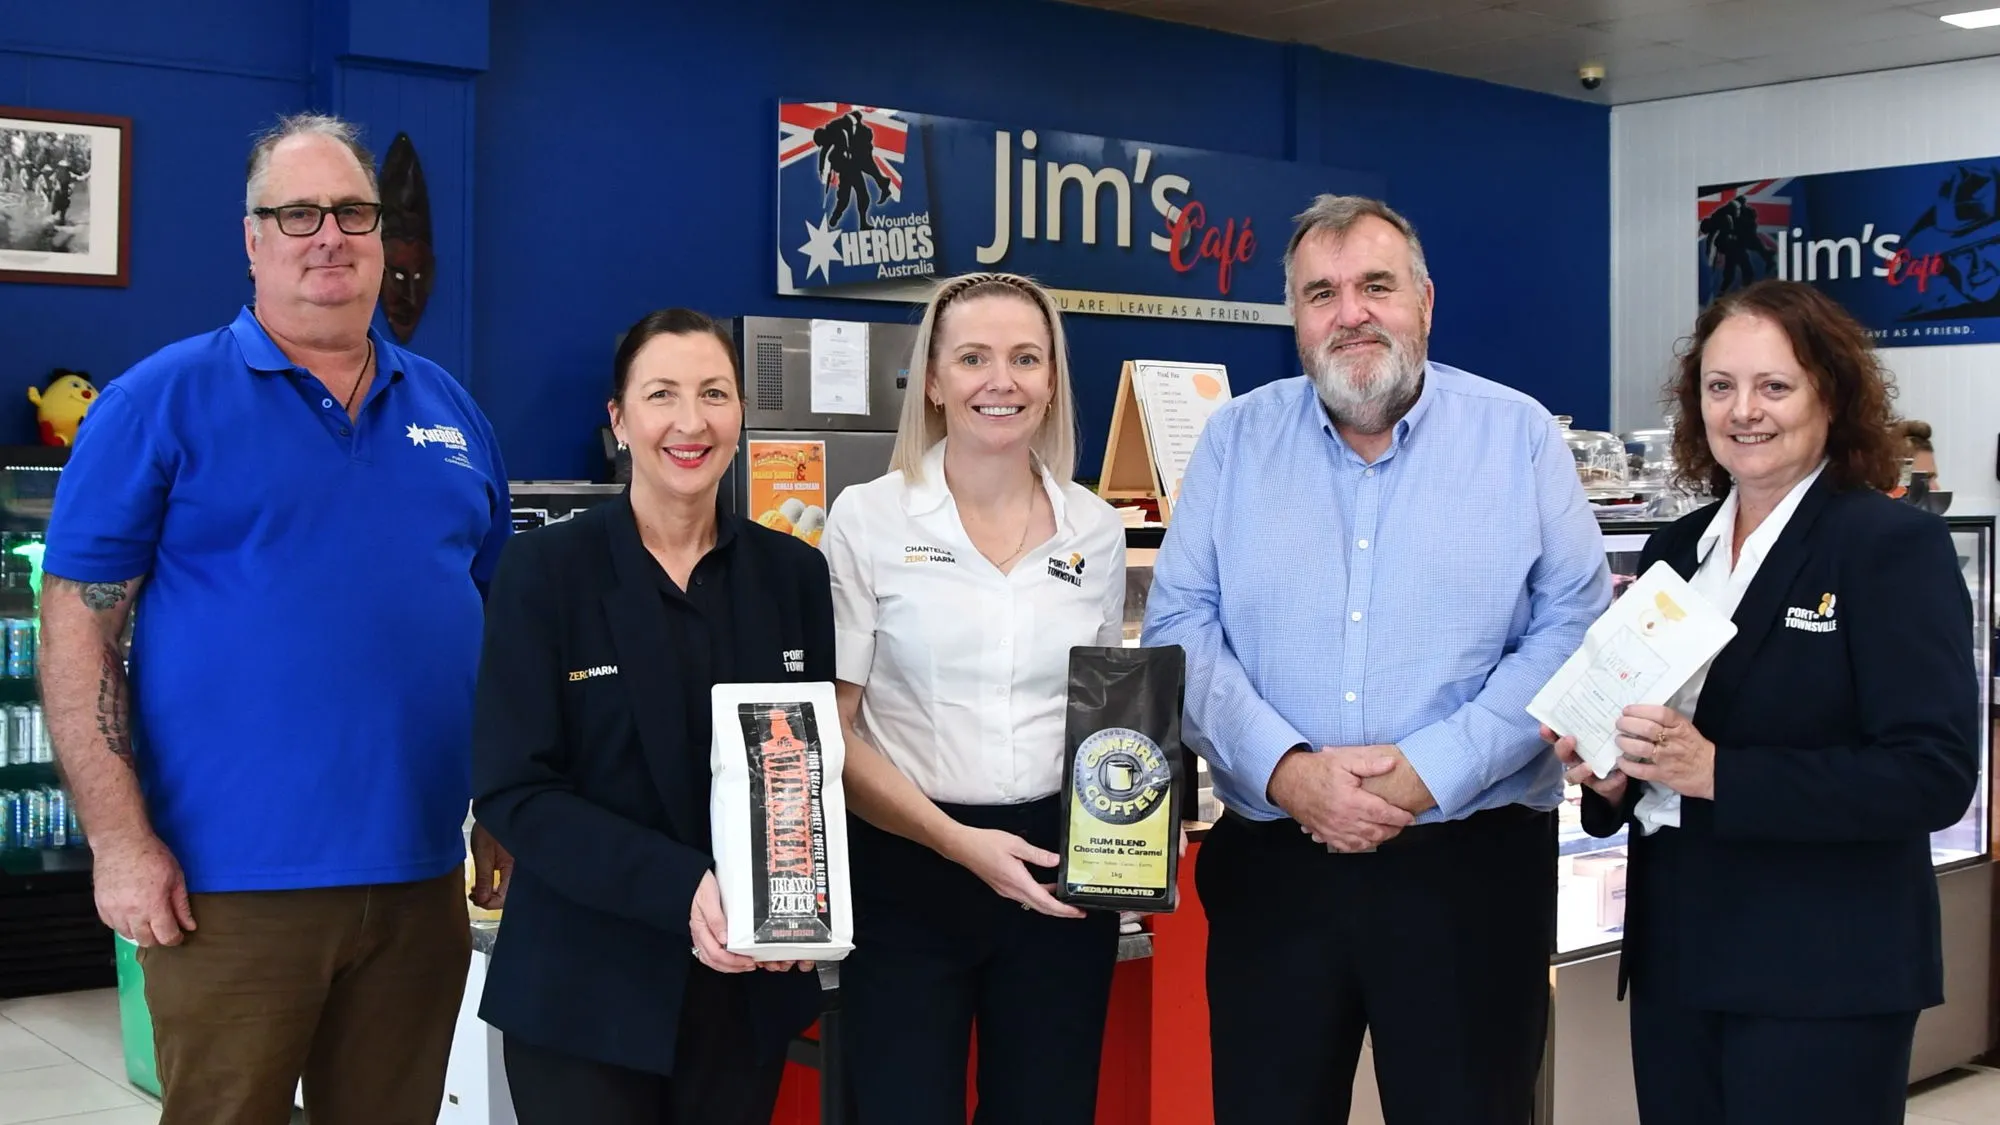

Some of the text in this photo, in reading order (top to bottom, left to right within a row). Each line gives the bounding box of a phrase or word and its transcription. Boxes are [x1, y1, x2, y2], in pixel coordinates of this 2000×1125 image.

[976, 130, 1190, 264] Jim's
[870, 211, 930, 229] Wounded
[841, 225, 934, 267] HEROES
[1165, 201, 1256, 294] Café
[877, 260, 934, 279] Australia
[1078, 299, 1111, 312] ARE.
[1119, 302, 1163, 315] LEAVE
[1172, 306, 1187, 317] AS
[1196, 307, 1203, 317] A
[1211, 307, 1265, 321] FRIEND.
[1893, 328, 1908, 337] AS
[1912, 328, 1921, 337] A
[424, 428, 467, 447] HEROES
[904, 554, 956, 564] ZERO HARM
[1049, 557, 1067, 571] PORT
[1047, 565, 1082, 588] TOWNSVILLE
[1787, 607, 1815, 620] PORT
[1785, 617, 1837, 633] TOWNSVILLE
[588, 664, 618, 677] HARM
[1086, 737, 1160, 773] GUNFIRE
[810, 770, 821, 797] CREAM
[1085, 785, 1159, 817] COFFEE
[813, 833, 825, 861] COFFEE
[1074, 845, 1115, 855] Chocolate
[1127, 848, 1162, 857] Caramel
[1090, 837, 1146, 847] RUM BLEND
[815, 862, 826, 886] BLEND
[1111, 871, 1123, 879] 1kg
[770, 877, 815, 894] BRAVO
[1077, 886, 1155, 897] MEDIUM ROASTED
[771, 893, 815, 913] ZULU
